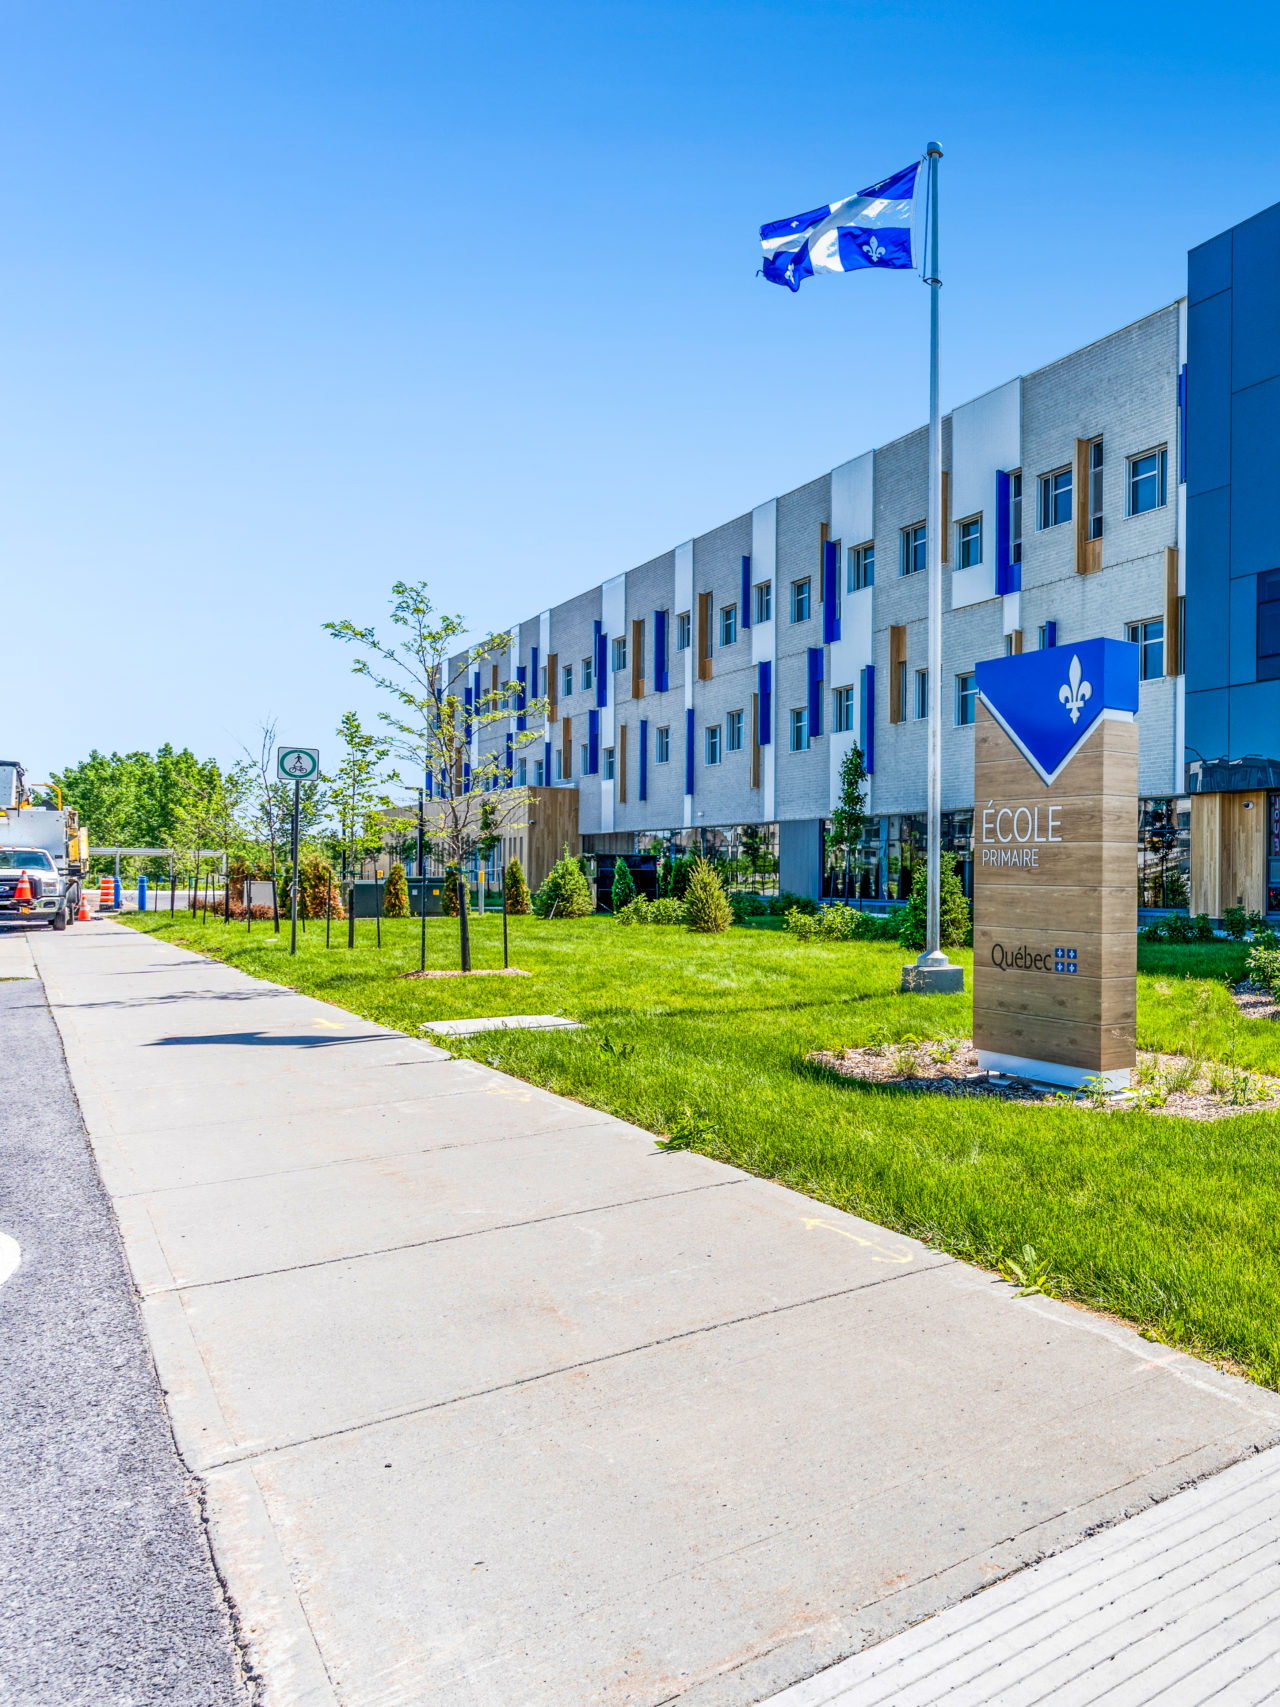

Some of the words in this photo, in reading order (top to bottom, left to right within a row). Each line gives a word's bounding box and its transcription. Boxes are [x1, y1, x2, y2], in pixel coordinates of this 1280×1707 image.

[982, 799, 1063, 843] ÉCOLE
[981, 848, 1040, 867] PRIMAIRE
[991, 943, 1052, 972] Québec
